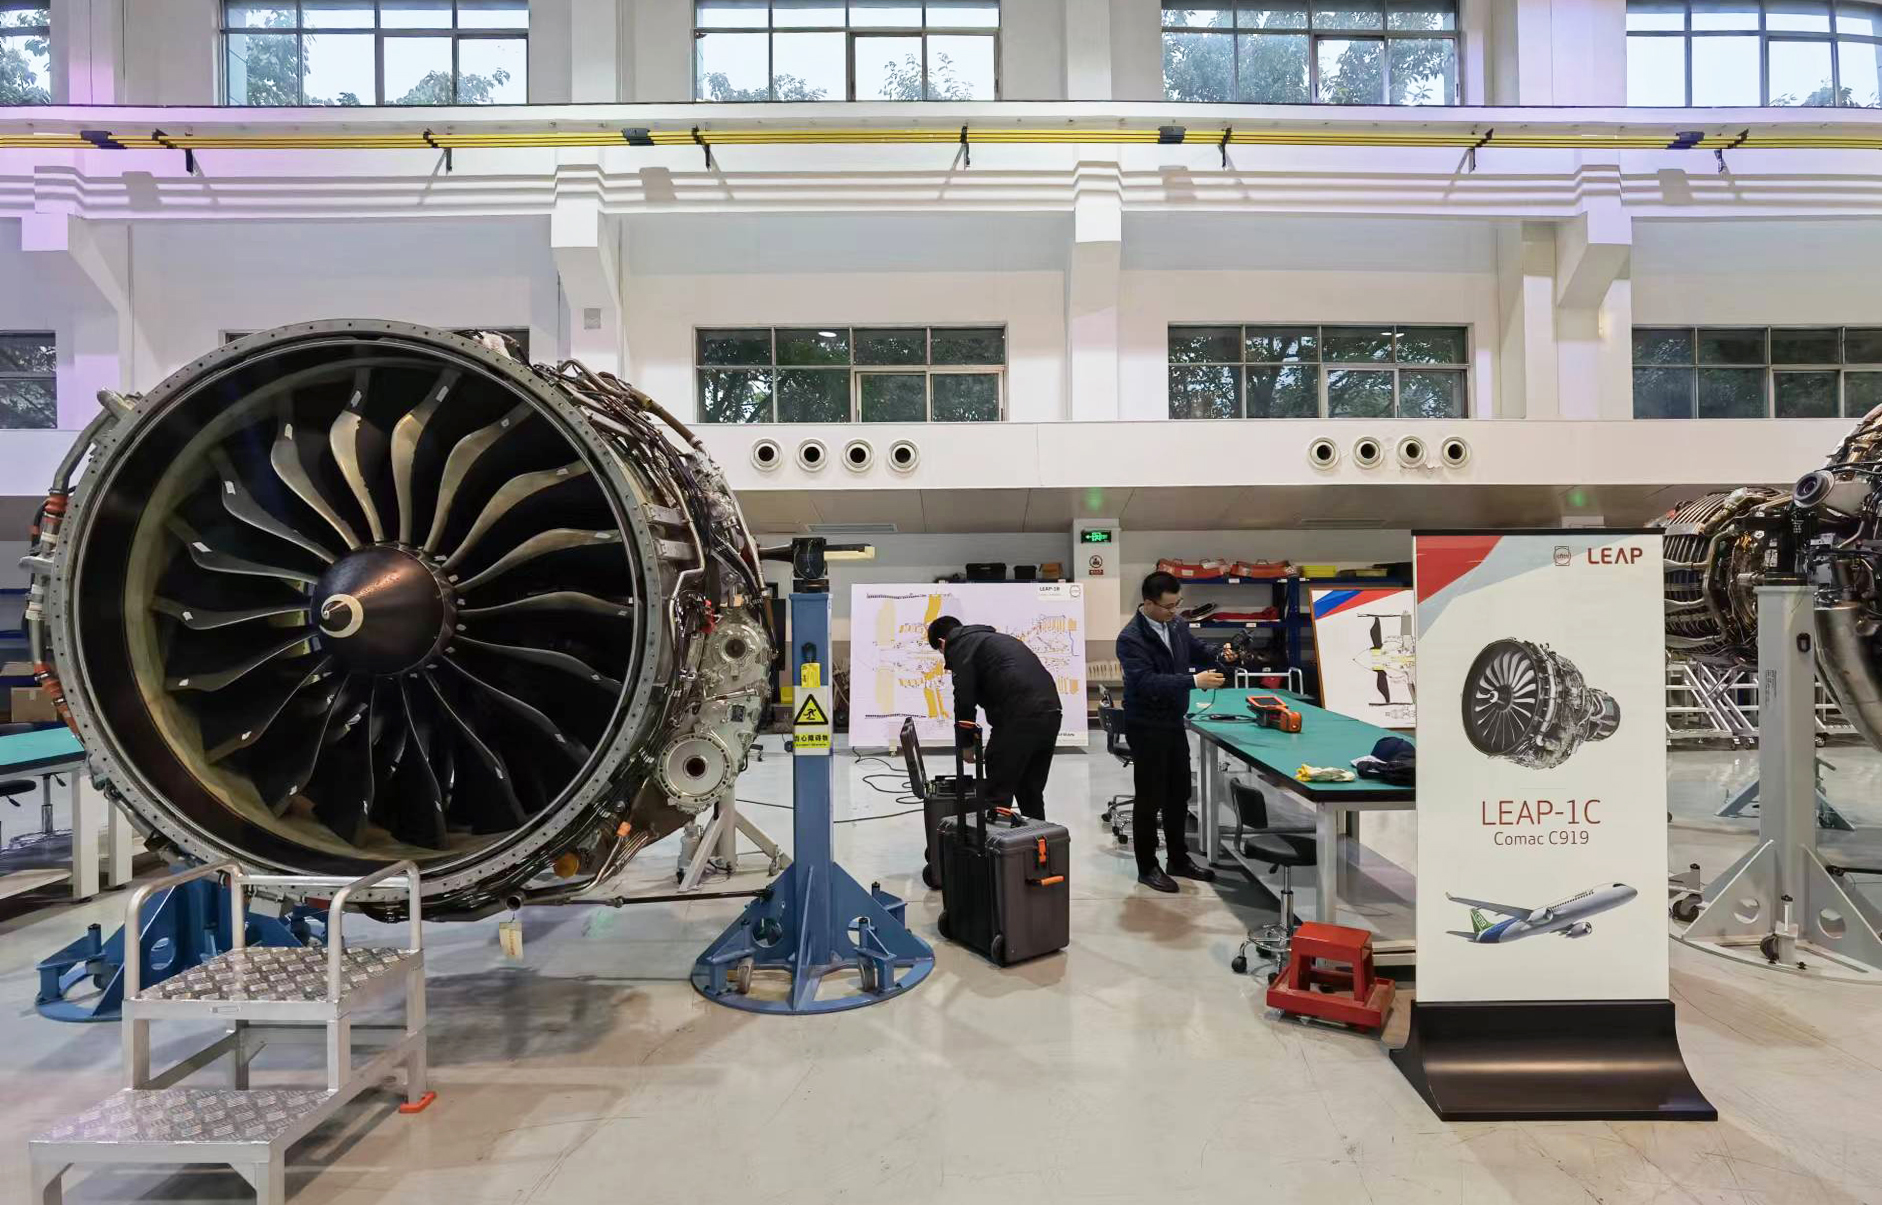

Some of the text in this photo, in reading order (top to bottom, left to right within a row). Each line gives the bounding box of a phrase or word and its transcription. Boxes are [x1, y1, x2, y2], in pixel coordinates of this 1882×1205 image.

[1587, 547, 1643, 564] LEAP
[1482, 799, 1601, 825] LEAP-1C
[1494, 830, 1589, 846] Comac C919
